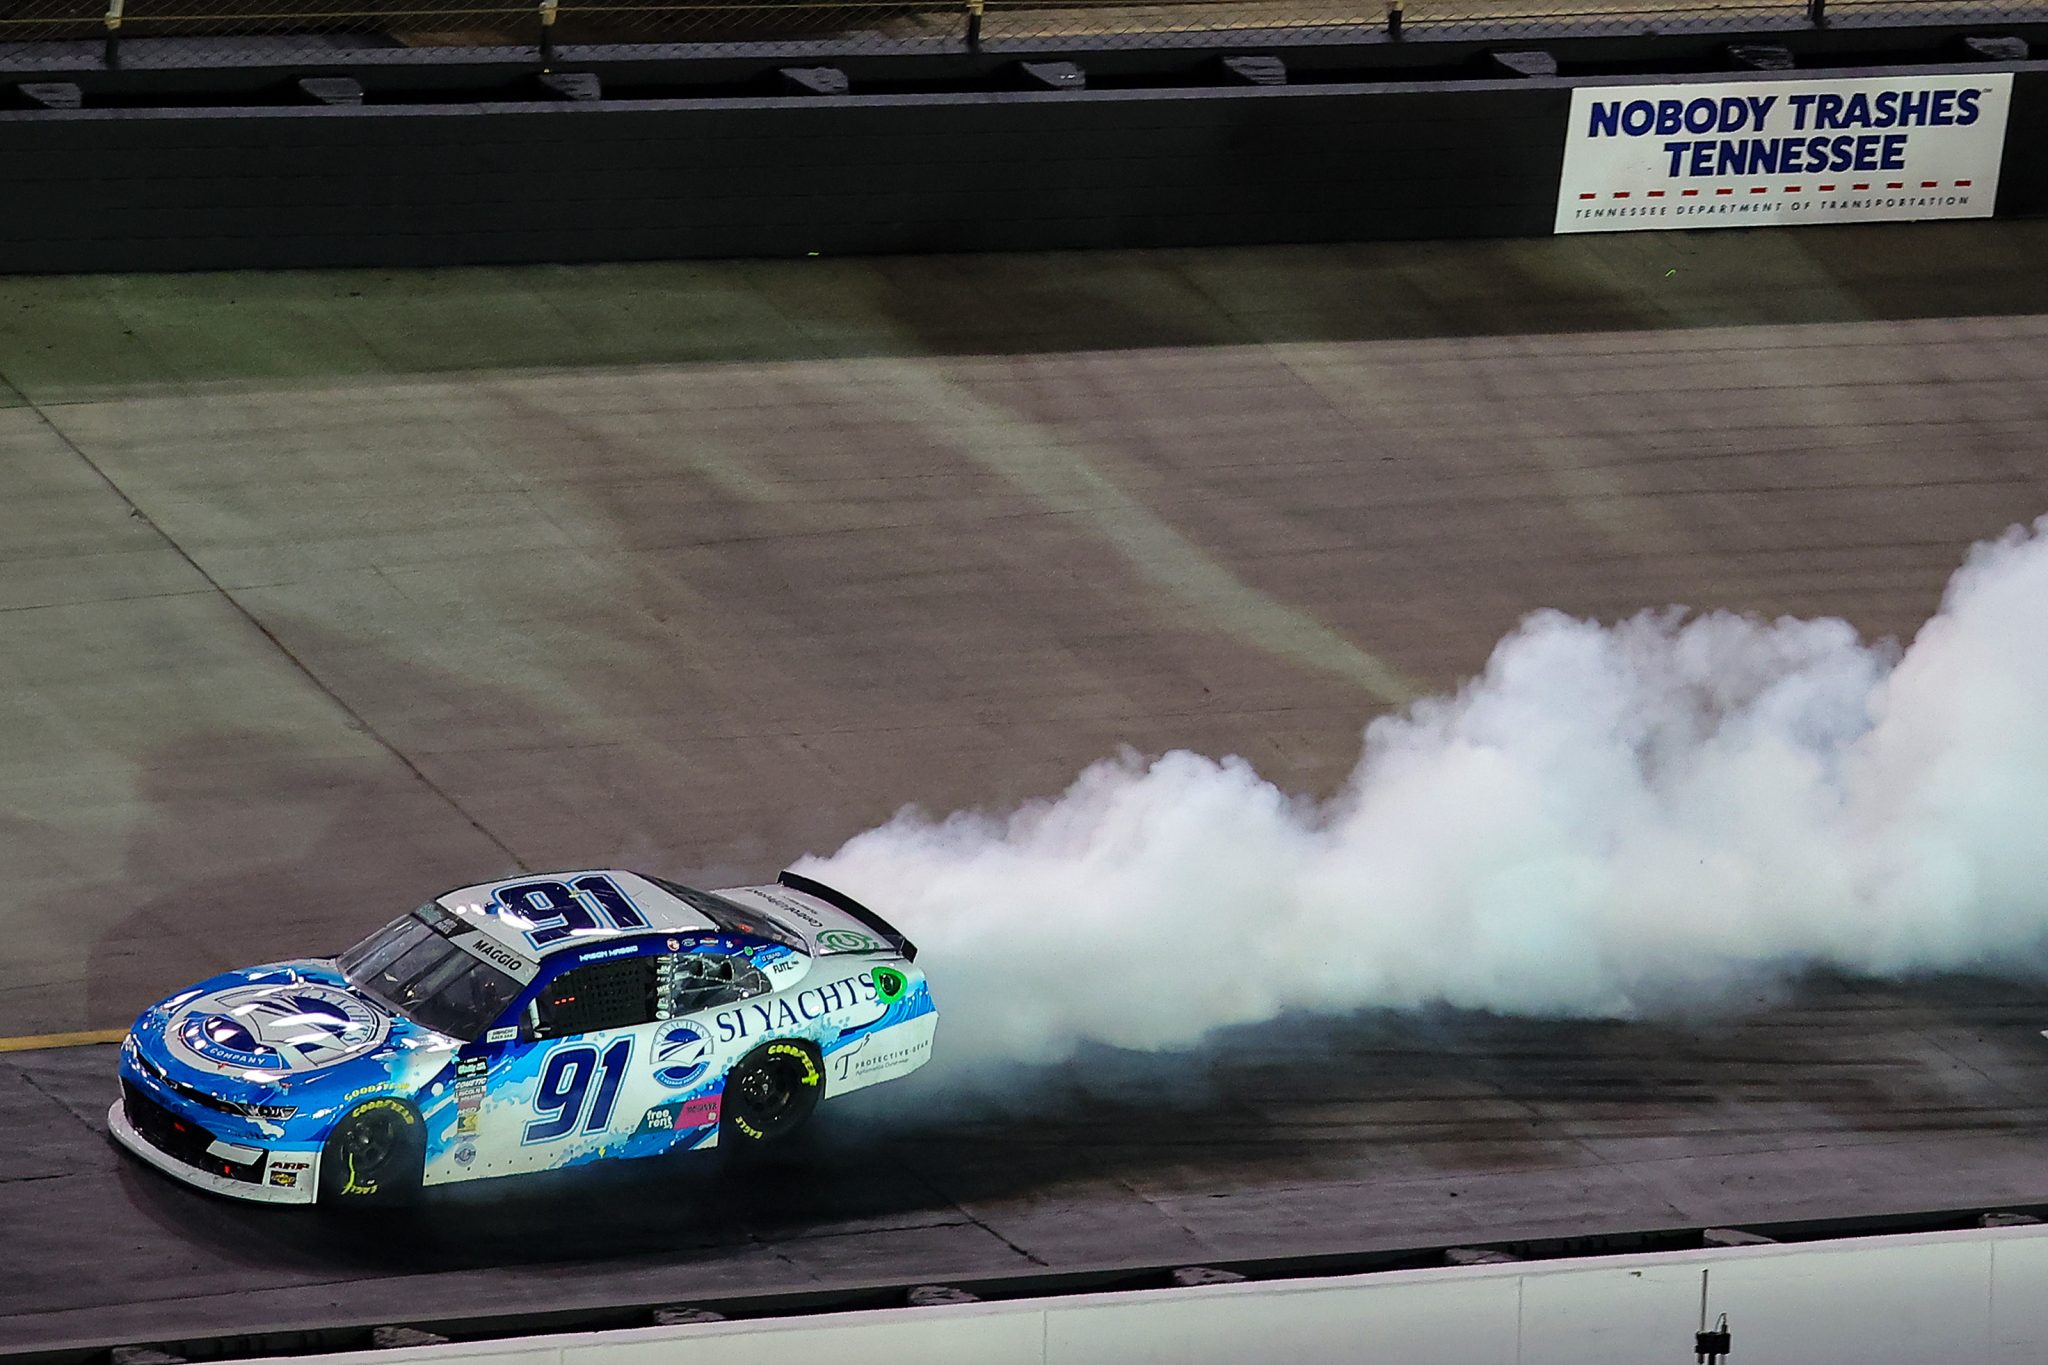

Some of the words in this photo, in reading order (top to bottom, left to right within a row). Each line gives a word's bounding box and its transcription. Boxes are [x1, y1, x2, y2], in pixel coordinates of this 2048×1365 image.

[1588, 95, 1778, 137] NOBODY
[1788, 88, 1982, 131] TRASHES
[1664, 134, 1909, 178] TENNESSEE
[1575, 206, 1668, 219] TENNESSEE
[1676, 202, 1782, 215] DEPARTMENT
[1790, 201, 1811, 211] OF
[1820, 197, 1970, 210] TRANSPORTATION
[491, 874, 653, 951] 91
[472, 939, 522, 971] MAGGIO
[716, 1008, 749, 1043] SI
[752, 972, 879, 1032] YACHTS
[209, 1047, 266, 1066] COMPANY
[855, 1048, 909, 1070] PROTECTIVE
[520, 1033, 636, 1147] 91
[646, 1109, 670, 1120] free
[648, 1115, 672, 1129] rent
[735, 1115, 764, 1140] EAGLE
[269, 1162, 310, 1170] ARP
